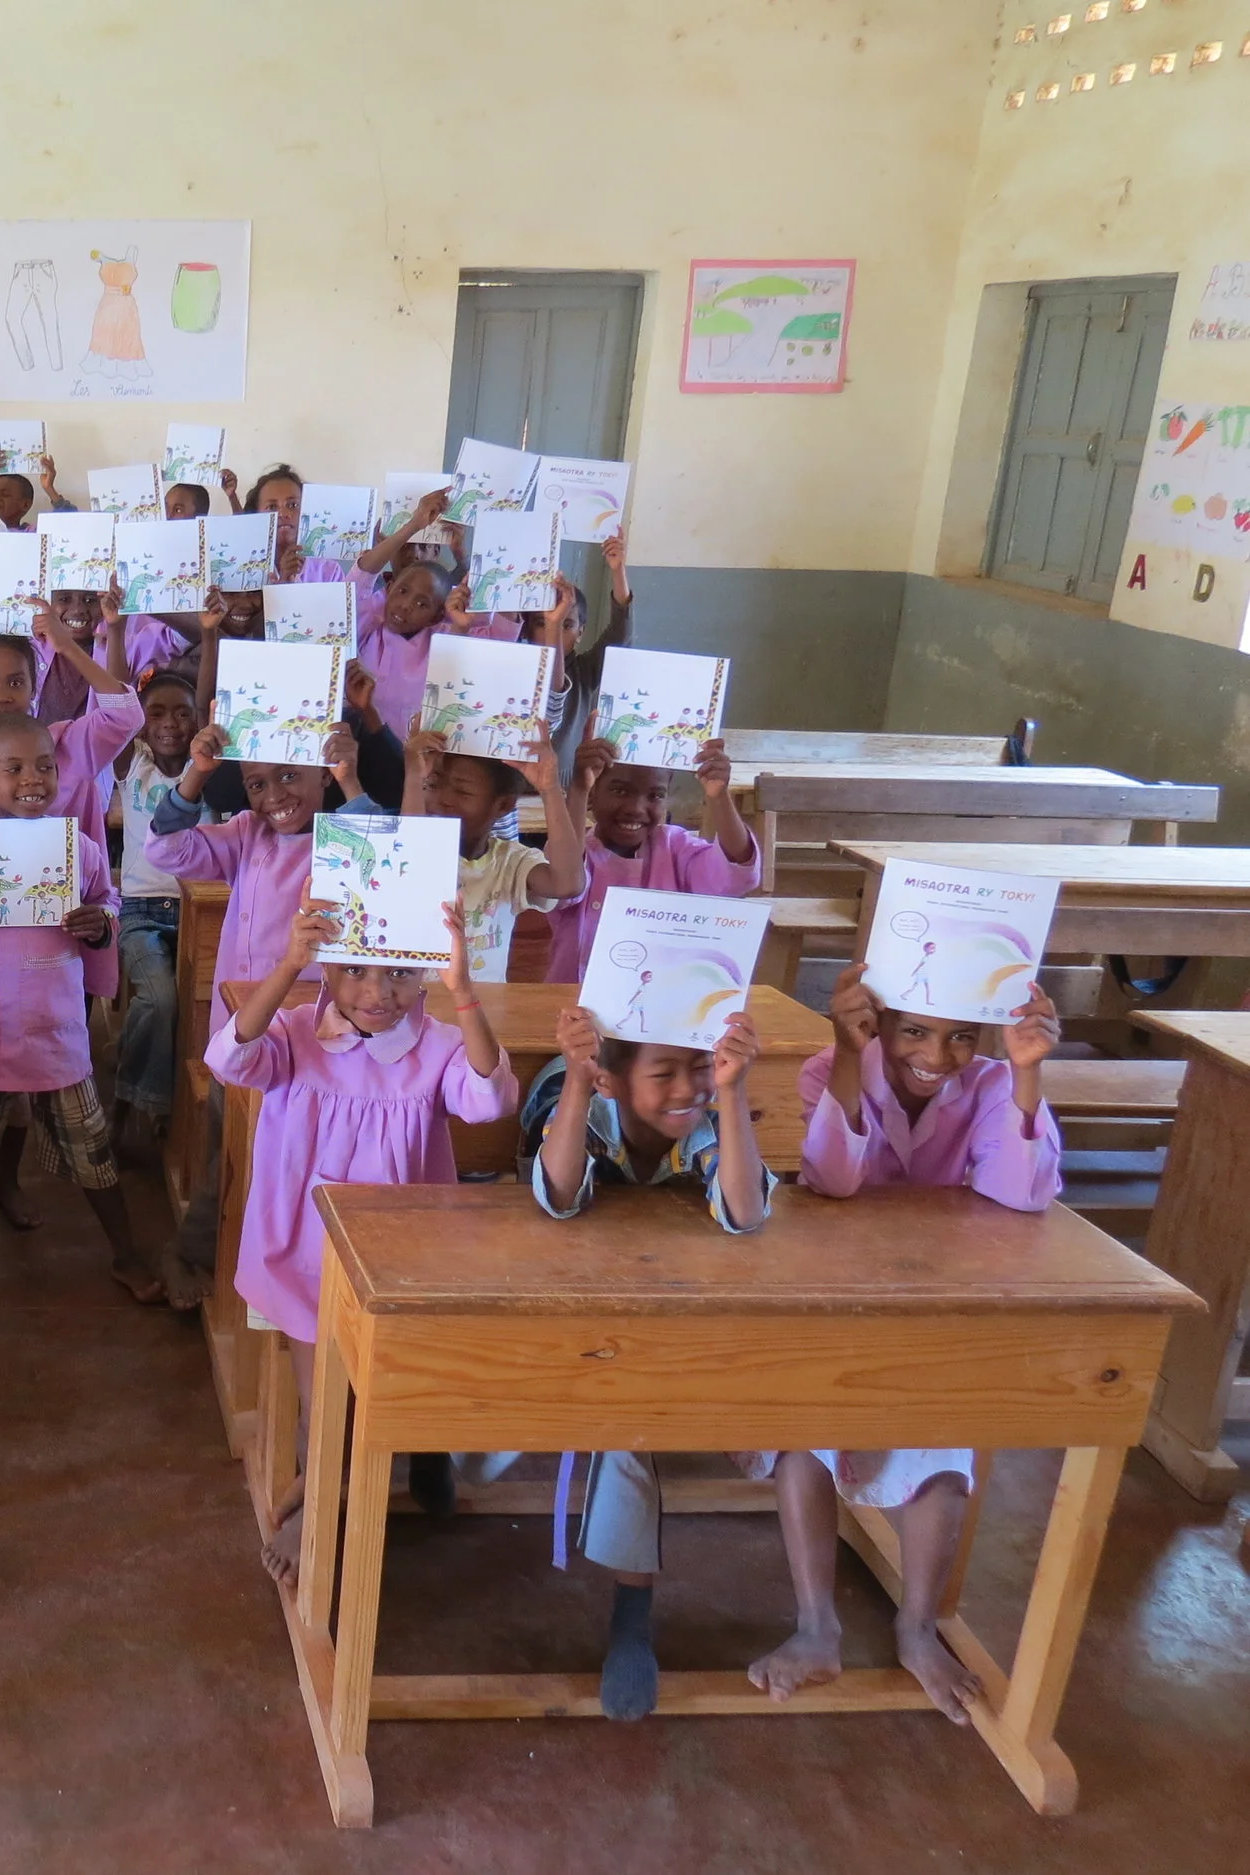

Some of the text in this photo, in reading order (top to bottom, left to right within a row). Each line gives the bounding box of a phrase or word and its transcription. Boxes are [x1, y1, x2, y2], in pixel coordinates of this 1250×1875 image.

[1126, 554, 1215, 603] A D
[904, 877, 1036, 903] MISAOTRA RY TOKY!
[625, 906, 748, 929] MISAOTRA RY TOKY!
